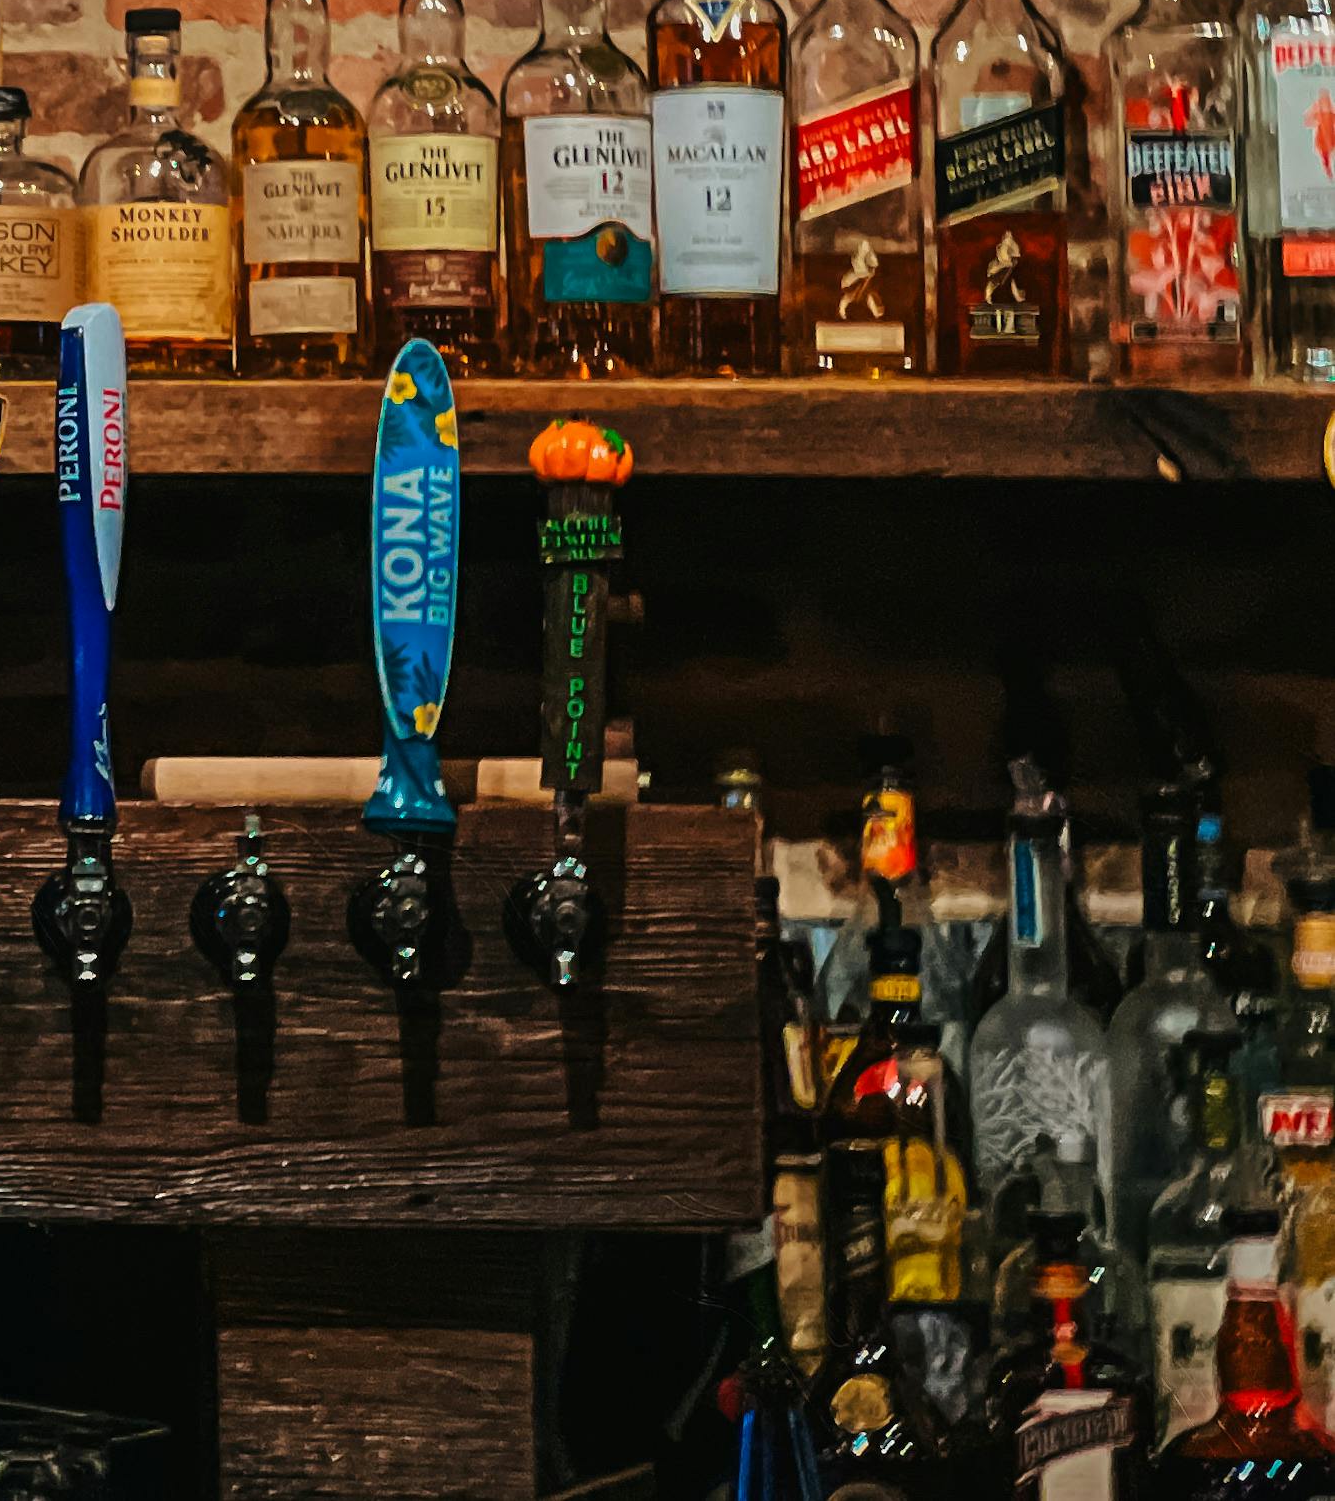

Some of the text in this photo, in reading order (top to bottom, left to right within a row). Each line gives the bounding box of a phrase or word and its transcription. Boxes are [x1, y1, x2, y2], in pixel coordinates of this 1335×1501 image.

[667, 146, 768, 164] MACALLAN
[798, 141, 838, 170] RED
[842, 116, 910, 154] LABEL
[1128, 140, 1233, 177] BEEFEATER
[385, 162, 484, 184] GLENLIVET
[111, 227, 211, 242] SHOULDER
[119, 208, 203, 224] MONKEY
[58, 386, 81, 503] PERONI
[99, 387, 122, 511] PERONI
[382, 467, 428, 624] KONA
[426, 465, 453, 627] BIG WAVE
[565, 573, 590, 781] BLUE POINT
